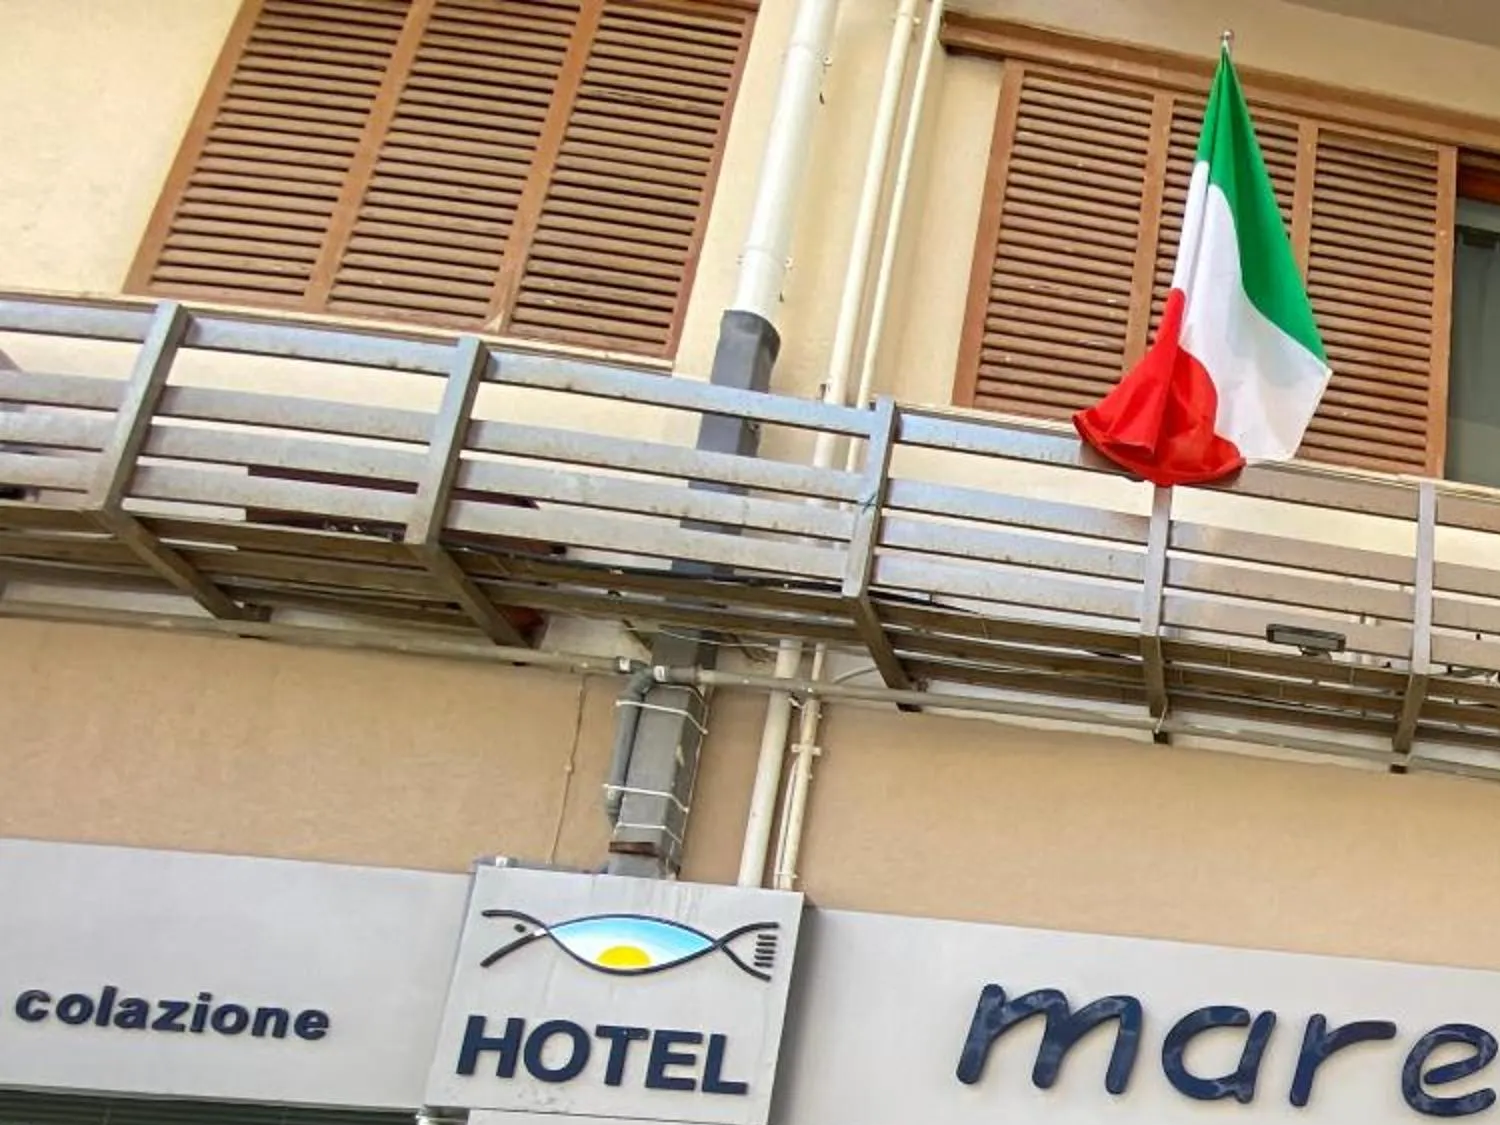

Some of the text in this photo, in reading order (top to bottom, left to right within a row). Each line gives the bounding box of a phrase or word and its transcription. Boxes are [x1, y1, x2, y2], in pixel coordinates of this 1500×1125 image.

[14, 984, 331, 1042] colazione
[955, 983, 1499, 1118] mare
[455, 1014, 749, 1096] HOTEL
